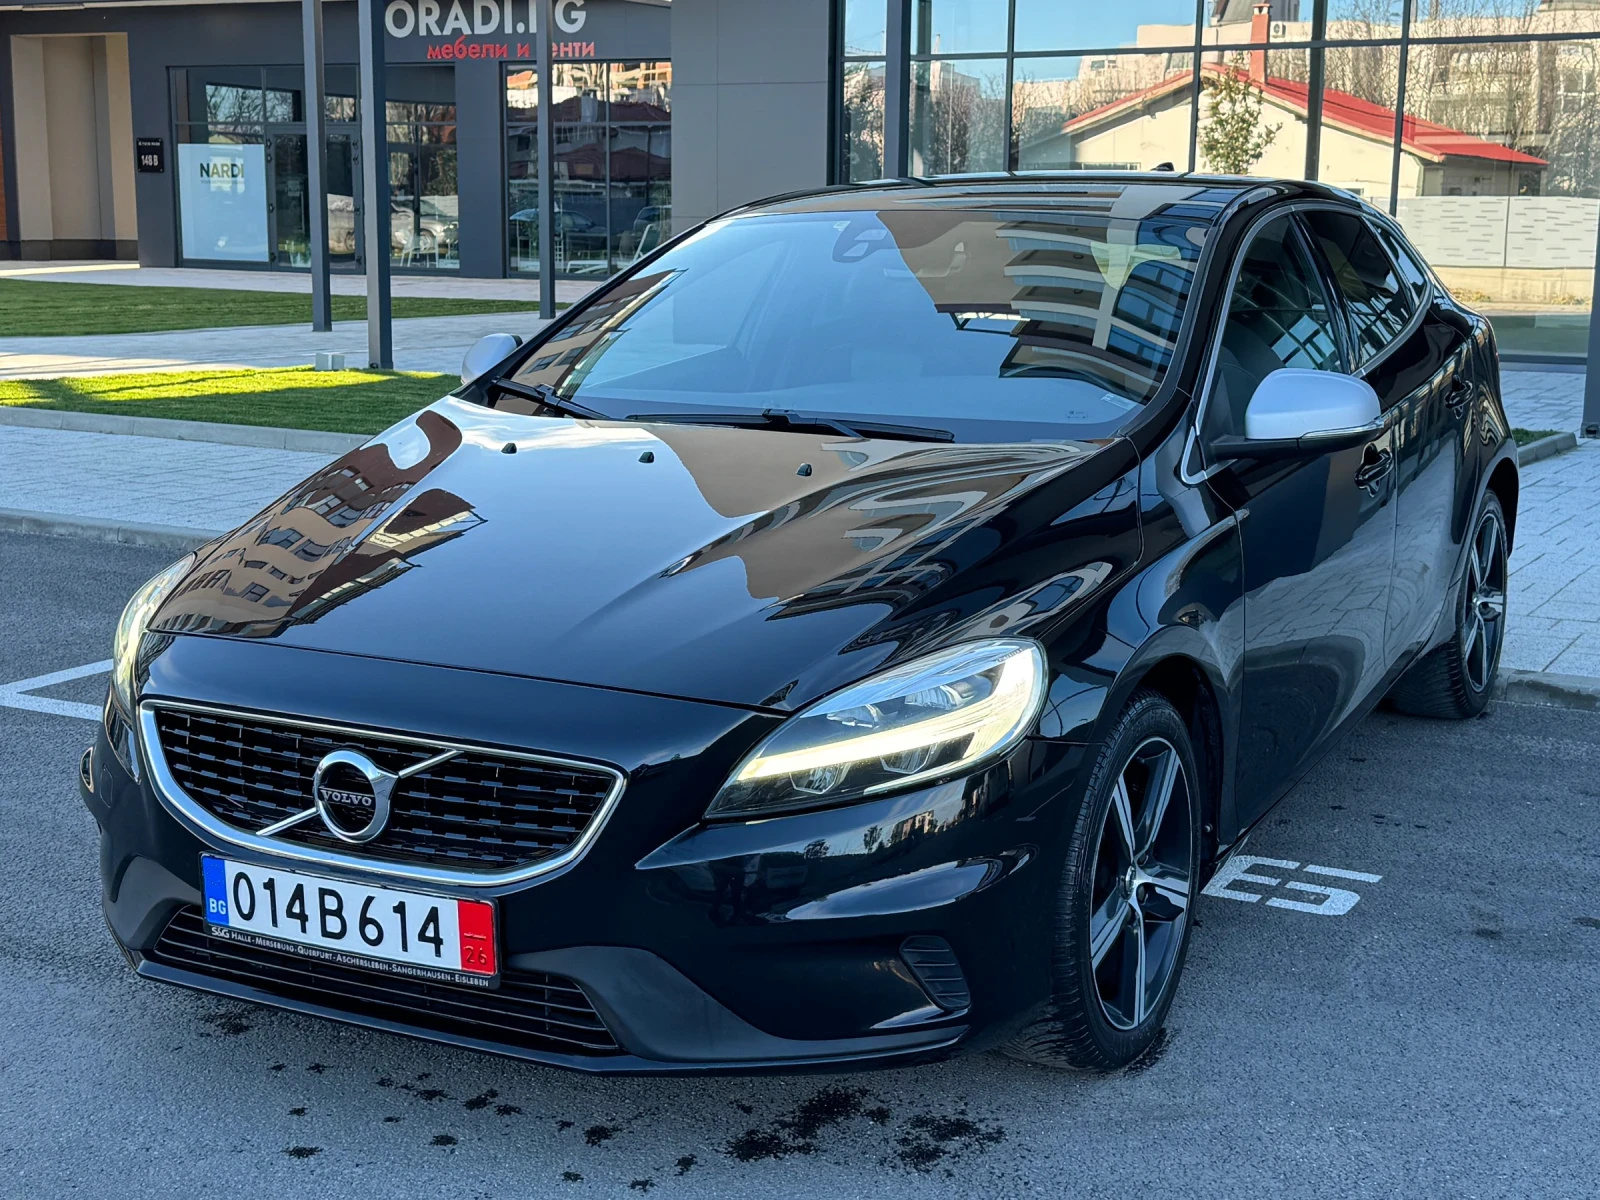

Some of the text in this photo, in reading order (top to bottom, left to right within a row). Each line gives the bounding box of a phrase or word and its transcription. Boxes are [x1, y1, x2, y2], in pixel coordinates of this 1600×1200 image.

[427, 34, 508, 59] мебели
[517, 43, 530, 57] и
[200, 163, 244, 178] NARDI
[320, 789, 372, 806] VOLVO
[209, 898, 227, 915] BG
[232, 871, 444, 958] 014B614
[211, 926, 230, 939] S&G
[231, 931, 252, 943] HALLE
[463, 945, 488, 965] 26
